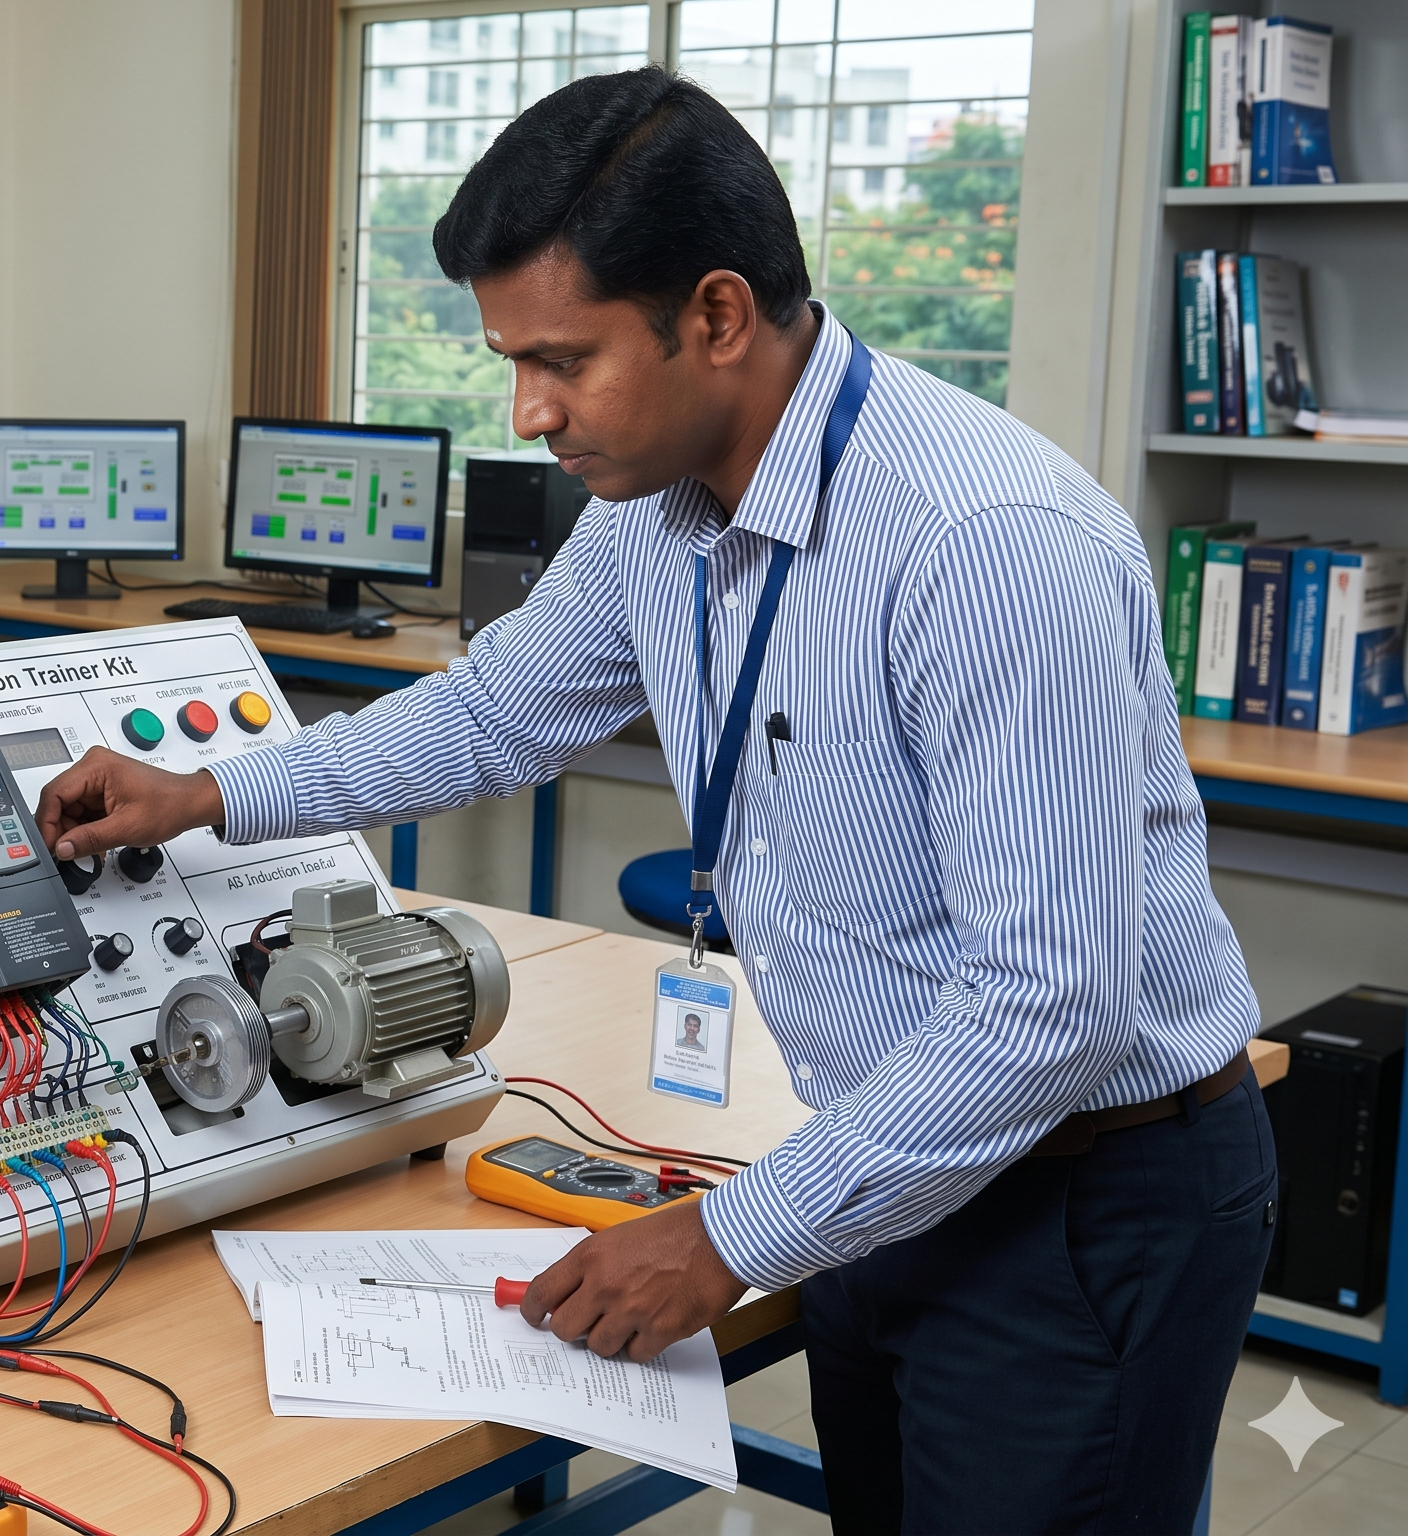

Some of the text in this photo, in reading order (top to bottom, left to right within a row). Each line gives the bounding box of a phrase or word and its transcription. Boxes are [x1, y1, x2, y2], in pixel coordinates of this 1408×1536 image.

[22, 662, 101, 688] Trainer
[106, 655, 138, 677] Kit
[110, 694, 138, 706] START
[245, 866, 301, 887] Induction
